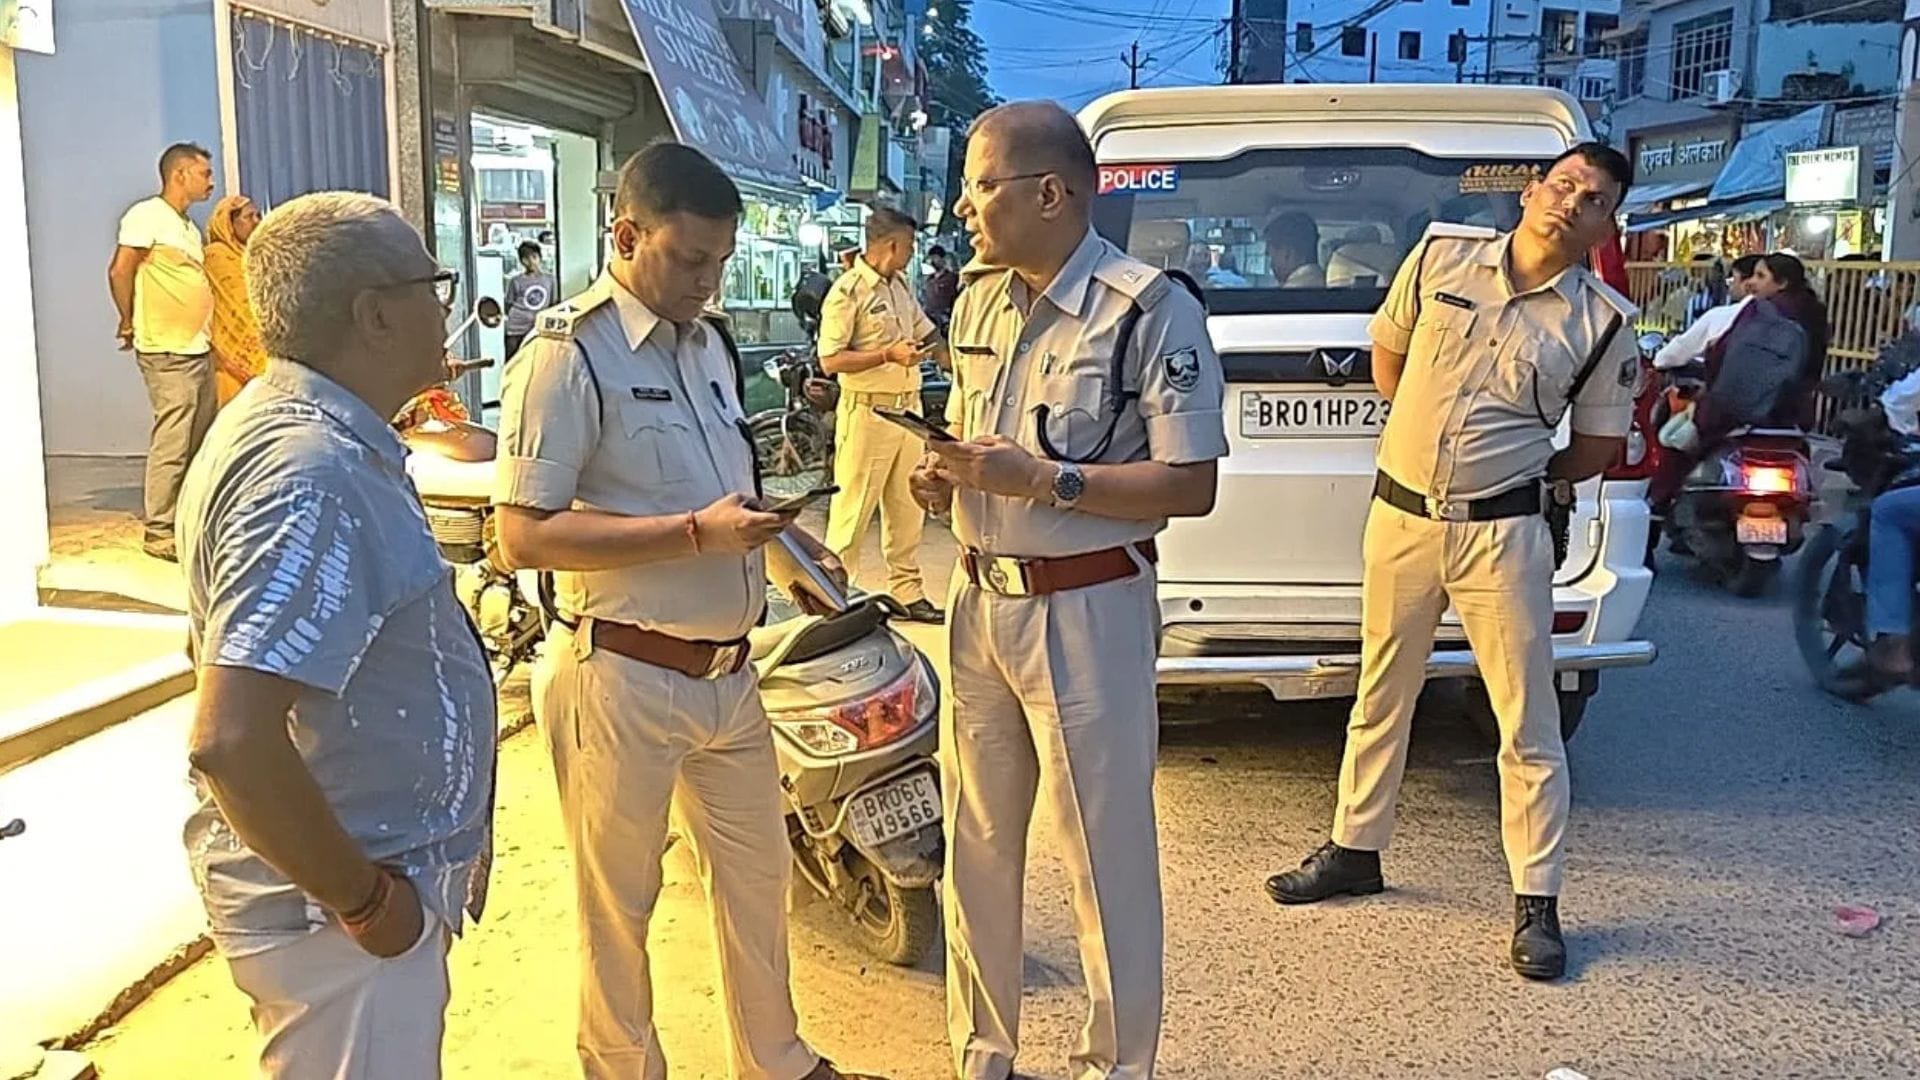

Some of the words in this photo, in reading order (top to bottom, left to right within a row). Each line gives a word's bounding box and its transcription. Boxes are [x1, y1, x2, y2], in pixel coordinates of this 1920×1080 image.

[654, 25, 746, 96] SWEETS
[1677, 137, 1725, 163] अलंकार
[1100, 169, 1175, 189] POLICE
[1259, 399, 1391, 427] BR01HP23
[862, 778, 927, 819] BR06C
[871, 800, 935, 841] W9566
